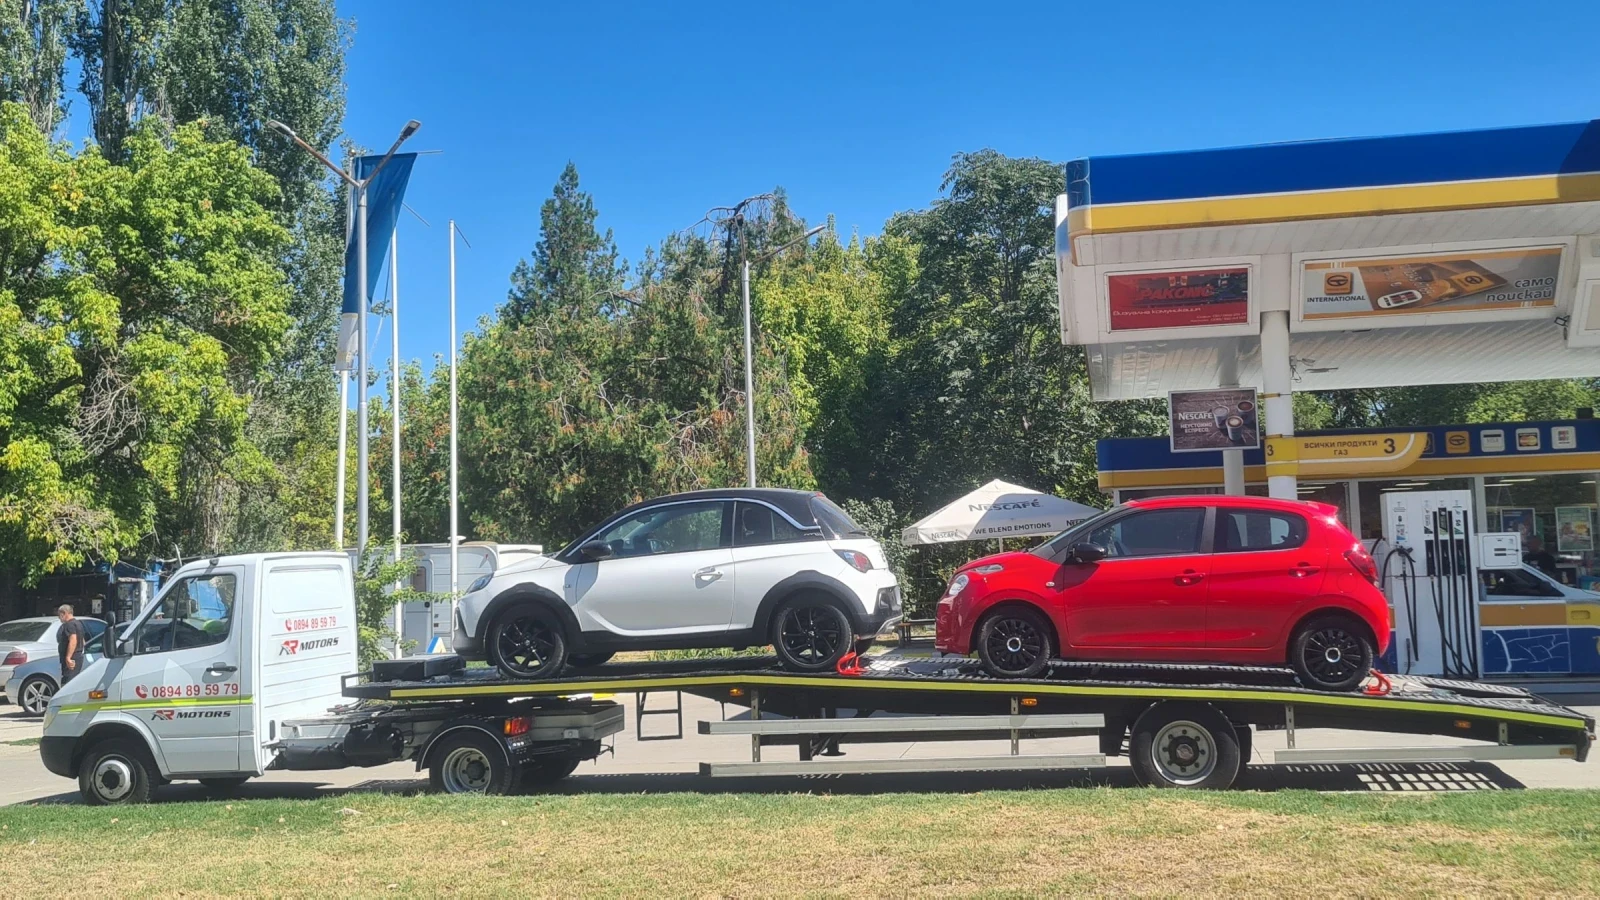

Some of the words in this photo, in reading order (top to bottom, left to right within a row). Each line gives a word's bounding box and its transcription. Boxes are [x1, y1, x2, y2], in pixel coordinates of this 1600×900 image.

[1514, 277, 1555, 288] само
[1307, 295, 1366, 303] INTERNATIONAL
[1486, 288, 1552, 302] поискай
[1267, 444, 1274, 456] 3
[1304, 441, 1336, 449] ВСИЧКИ
[1336, 440, 1378, 448] ПРОДУКТИ
[1383, 438, 1396, 454] 3
[968, 499, 1041, 512] NESCAFÉ
[974, 527, 986, 535] WE
[988, 525, 1012, 533] BLEND
[1014, 522, 1052, 532] EMOTIONS
[294, 619, 309, 630] 0894
[311, 618, 318, 629] 89
[320, 617, 327, 628] 59
[329, 616, 336, 627] 79
[300, 637, 339, 651] MOTORS
[152, 685, 181, 698] 0894
[186, 684, 200, 697] 89
[205, 684, 219, 696] 59
[223, 683, 238, 695] 79
[176, 710, 231, 719] MOTORS
